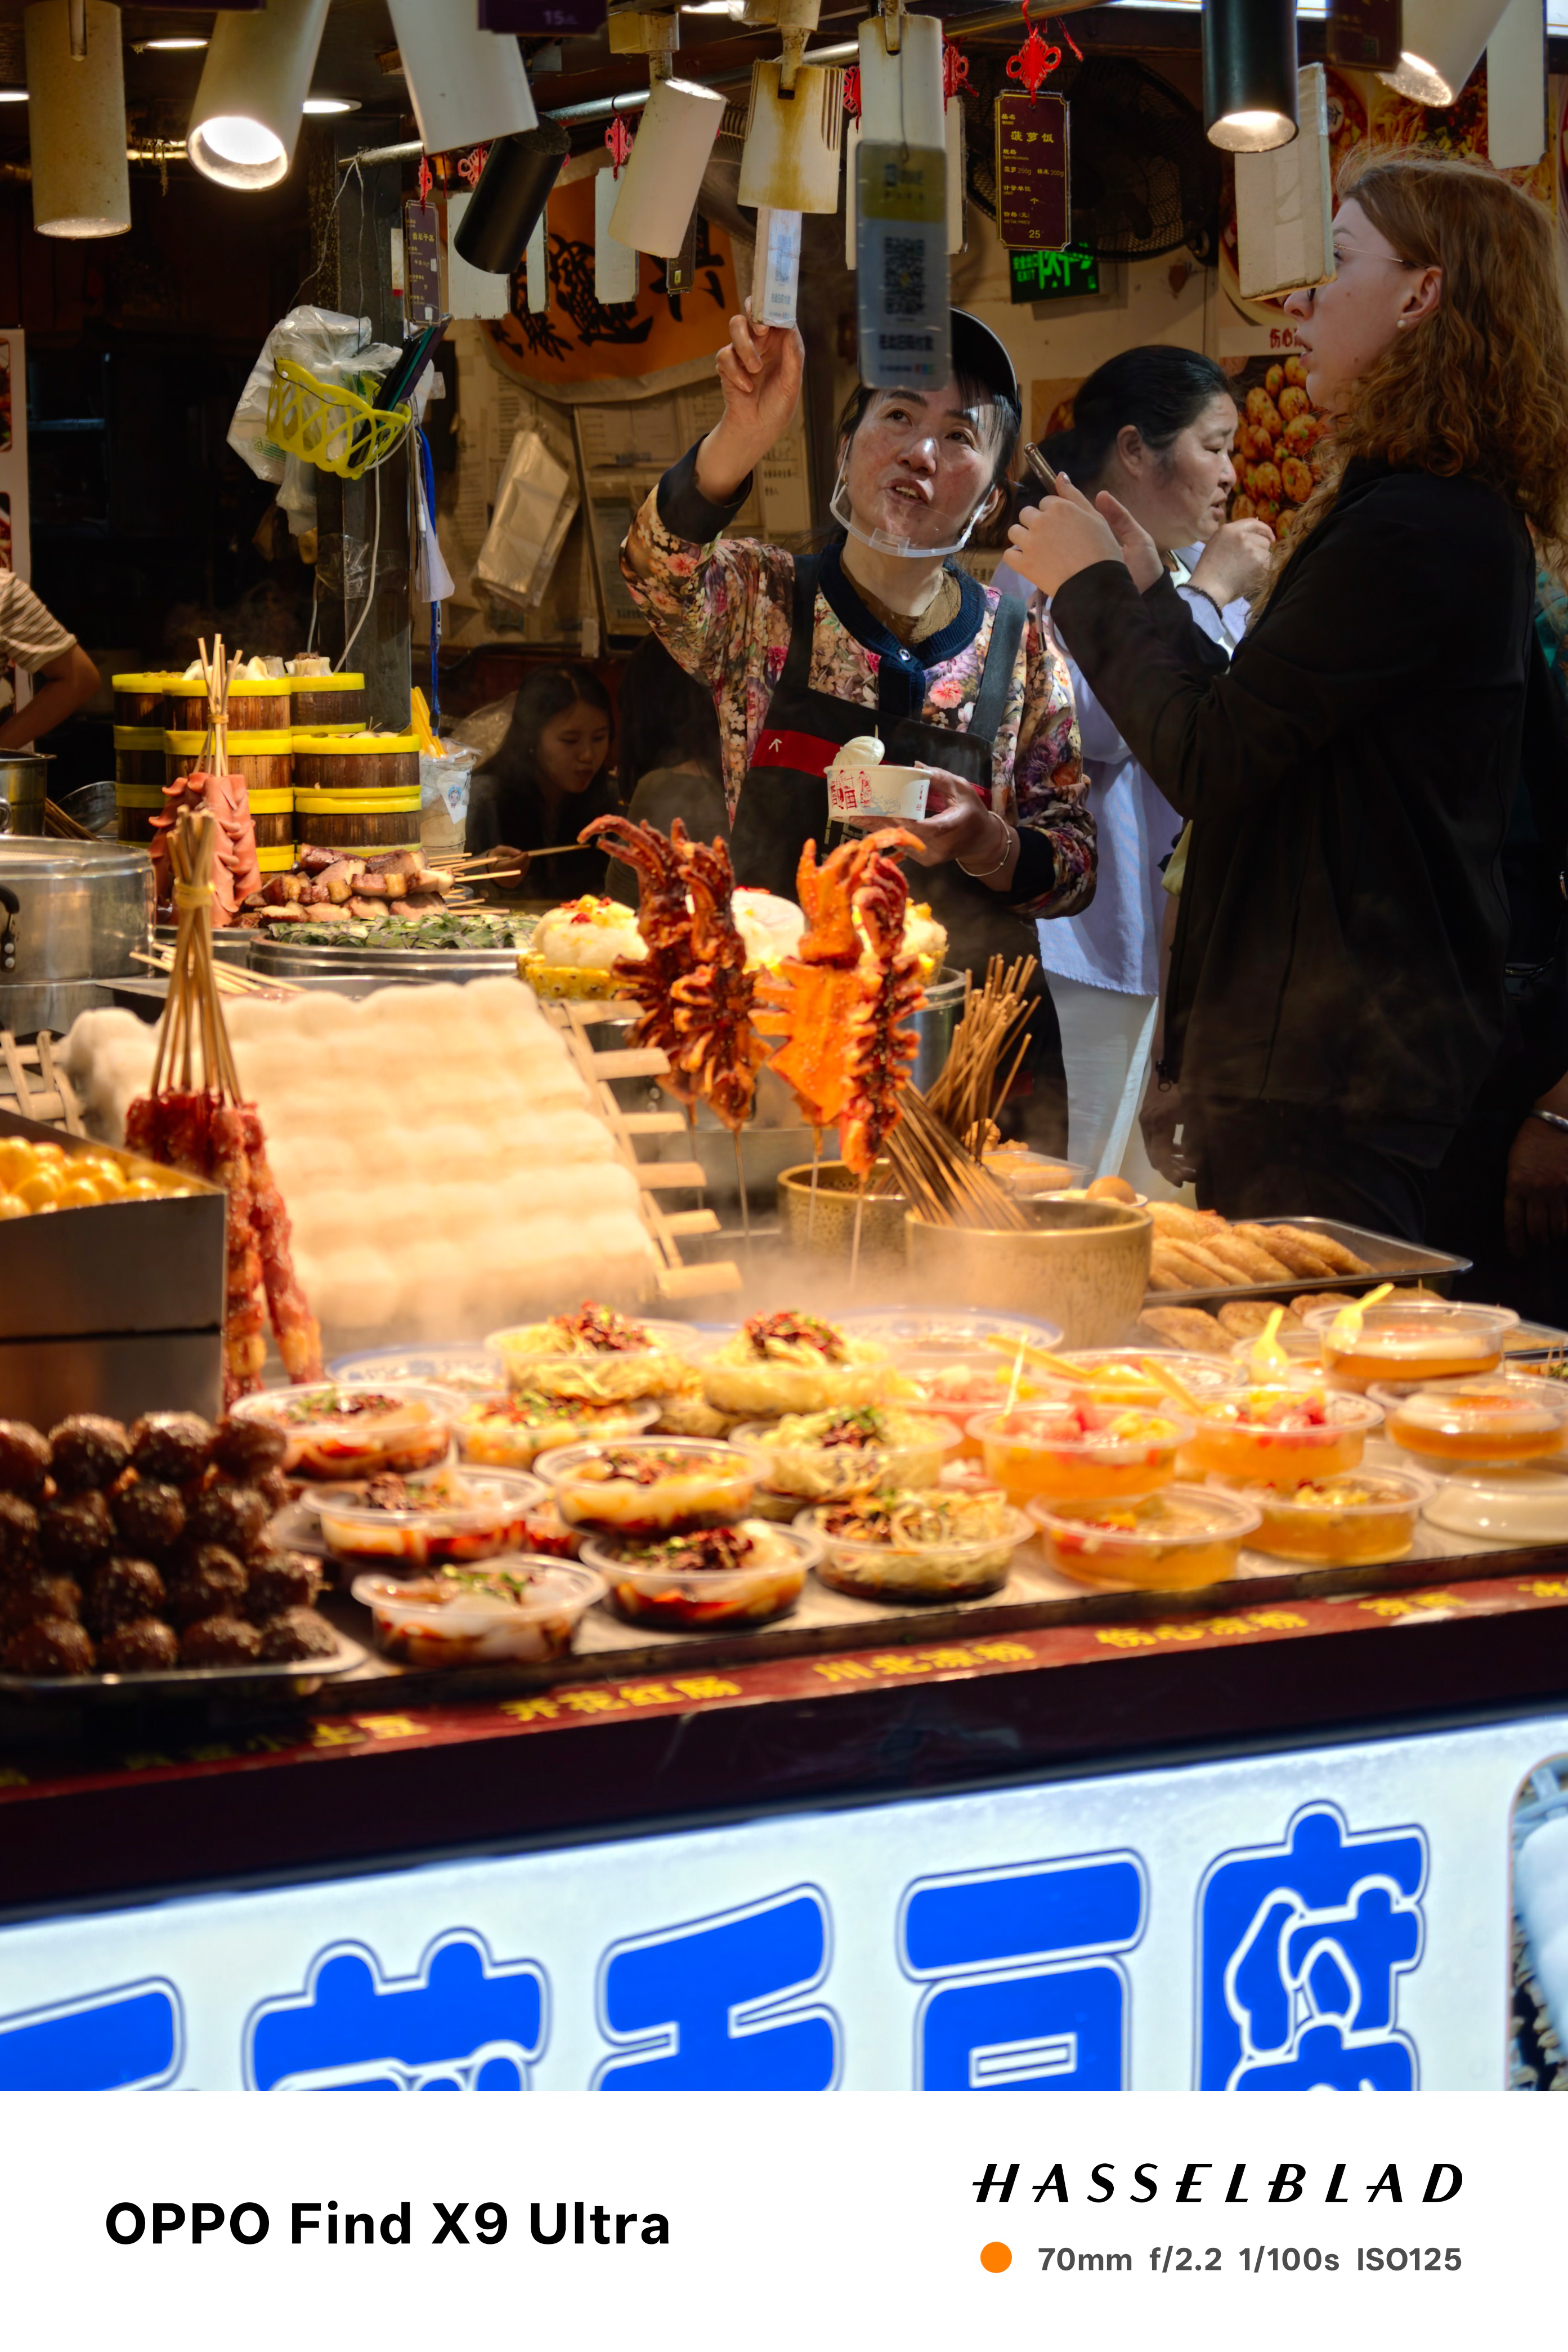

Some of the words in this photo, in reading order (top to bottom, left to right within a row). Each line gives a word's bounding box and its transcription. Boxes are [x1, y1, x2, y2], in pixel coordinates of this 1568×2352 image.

[1010, 131, 1054, 144] 菠萝饭
[1029, 230, 1041, 239] 25
[1096, 1610, 1309, 1648] 伤心凉粉
[812, 1641, 1036, 1682] 川北凉粉
[500, 1675, 742, 1721] 开花红肠
